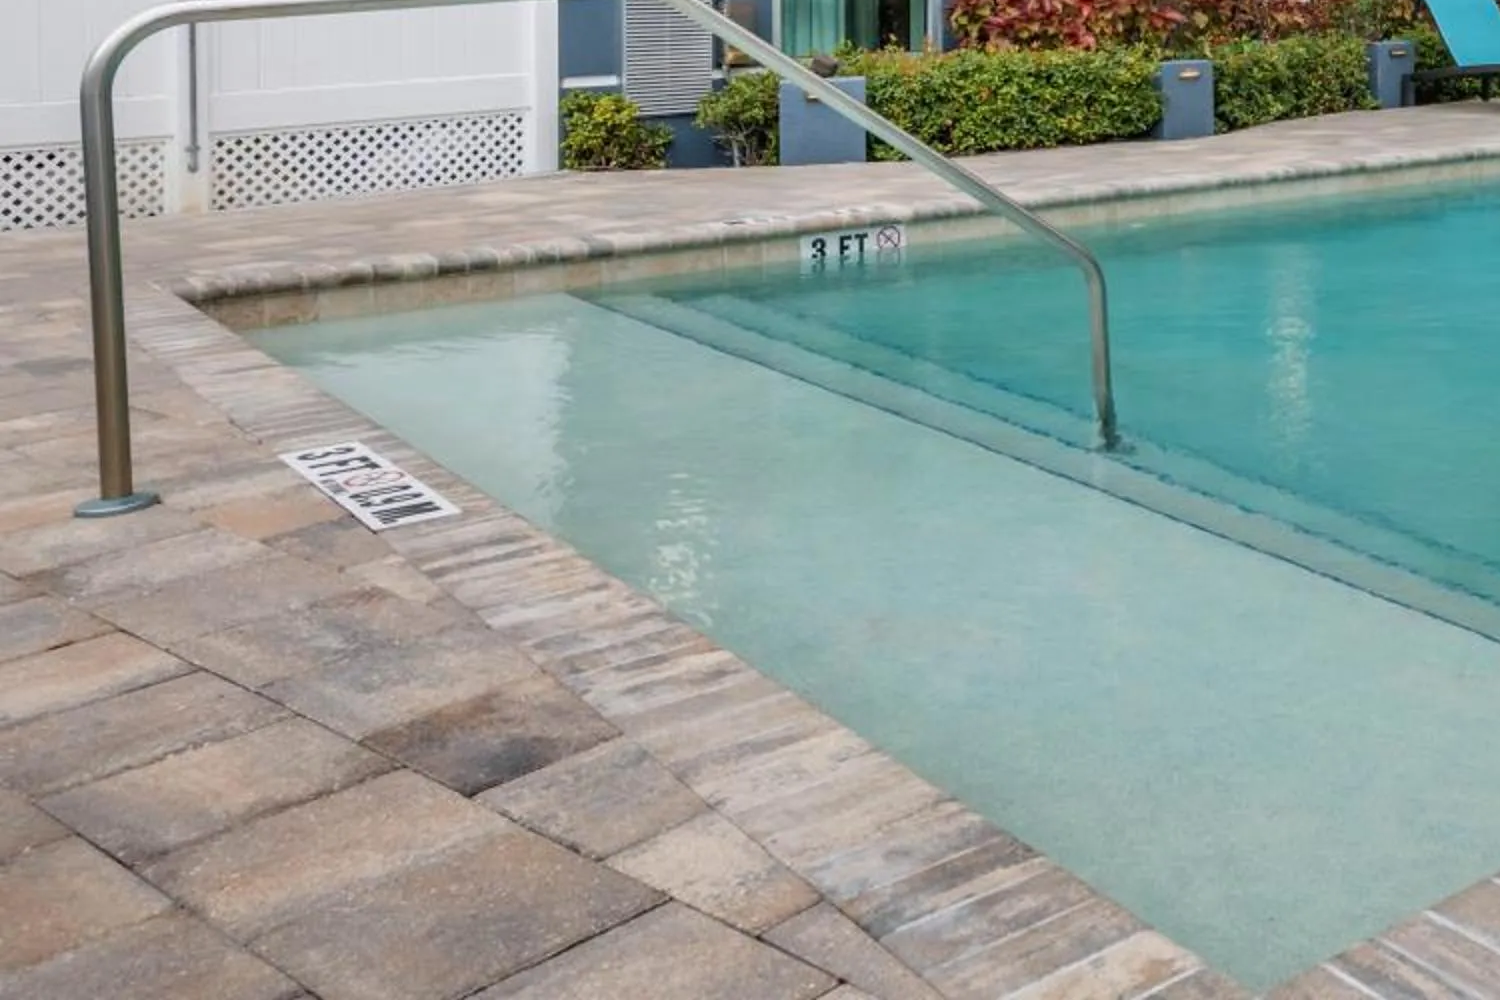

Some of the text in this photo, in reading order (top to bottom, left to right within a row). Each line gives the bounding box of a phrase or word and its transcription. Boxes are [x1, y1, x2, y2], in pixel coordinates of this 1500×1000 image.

[811, 233, 869, 259] 3 FT
[296, 446, 357, 461] 3
[308, 455, 382, 477] FT
